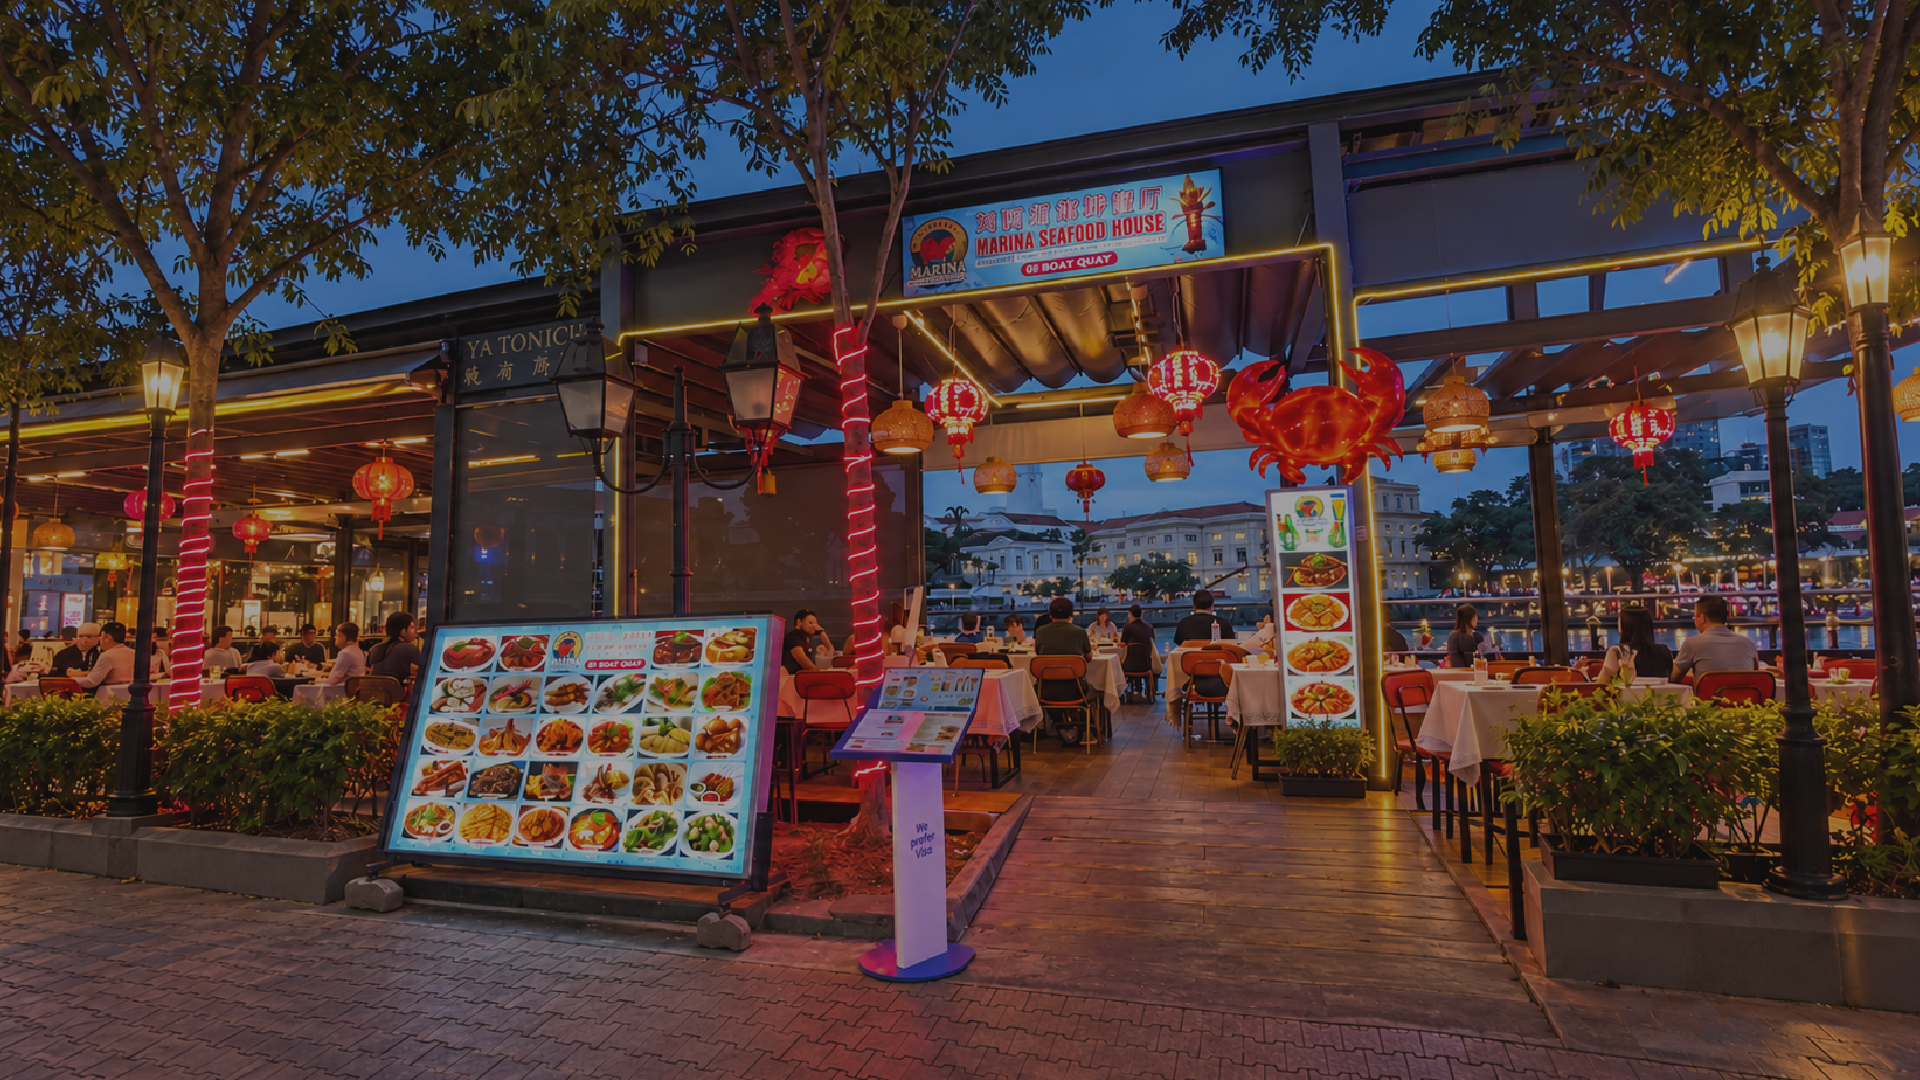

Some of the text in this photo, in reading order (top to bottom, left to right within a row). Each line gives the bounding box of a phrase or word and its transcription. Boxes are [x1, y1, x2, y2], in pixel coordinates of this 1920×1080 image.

[977, 231, 1034, 256] MARINA
[1039, 221, 1106, 248] SEAFOOD
[1112, 213, 1165, 238] HOUSE
[910, 260, 966, 279] MARINA
[1042, 260, 1074, 272] BOAT
[1077, 254, 1112, 268] QUAY
[467, 339, 493, 359] YA
